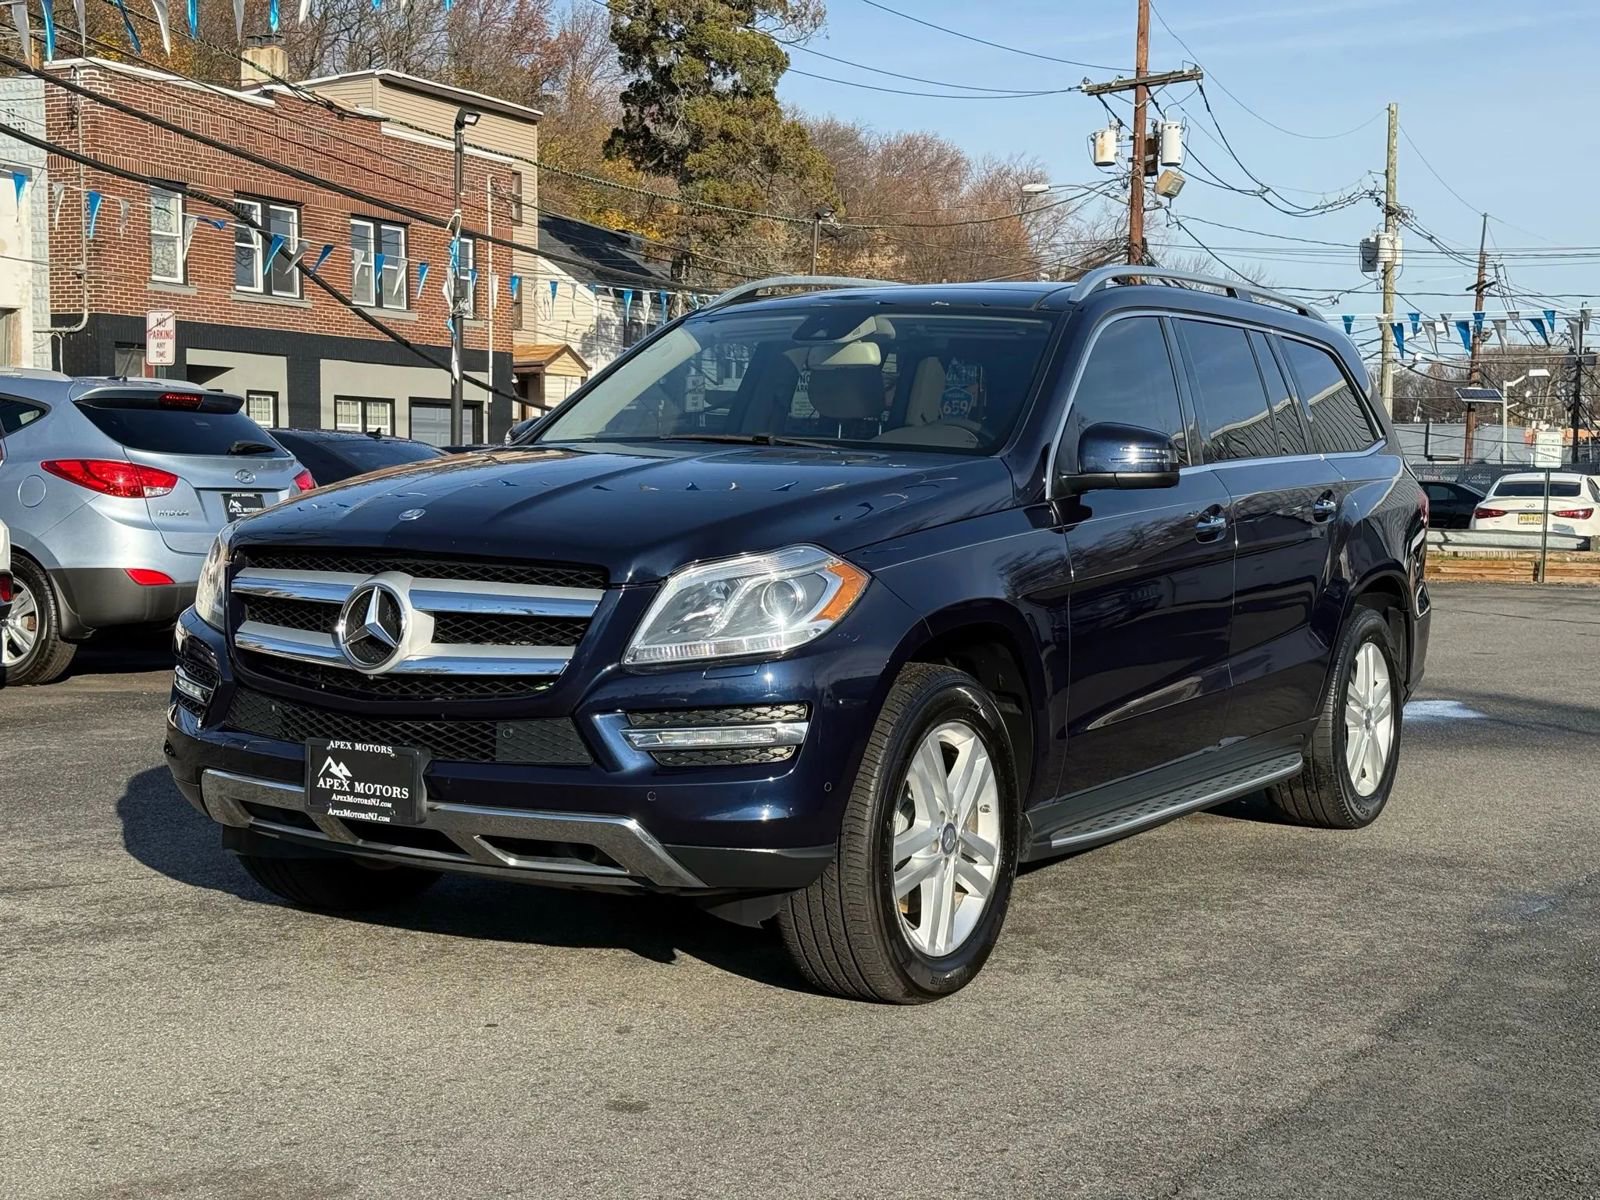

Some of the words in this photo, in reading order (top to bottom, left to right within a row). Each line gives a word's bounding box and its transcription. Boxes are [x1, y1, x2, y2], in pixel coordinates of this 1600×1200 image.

[156, 317, 167, 328] NO
[148, 329, 174, 340] PARKING
[155, 350, 166, 359] TIME
[943, 400, 969, 416] 659
[328, 740, 352, 750] APEX
[354, 742, 393, 754] MOTORS
[317, 777, 351, 792] APEX
[354, 781, 409, 799] MOTORS
